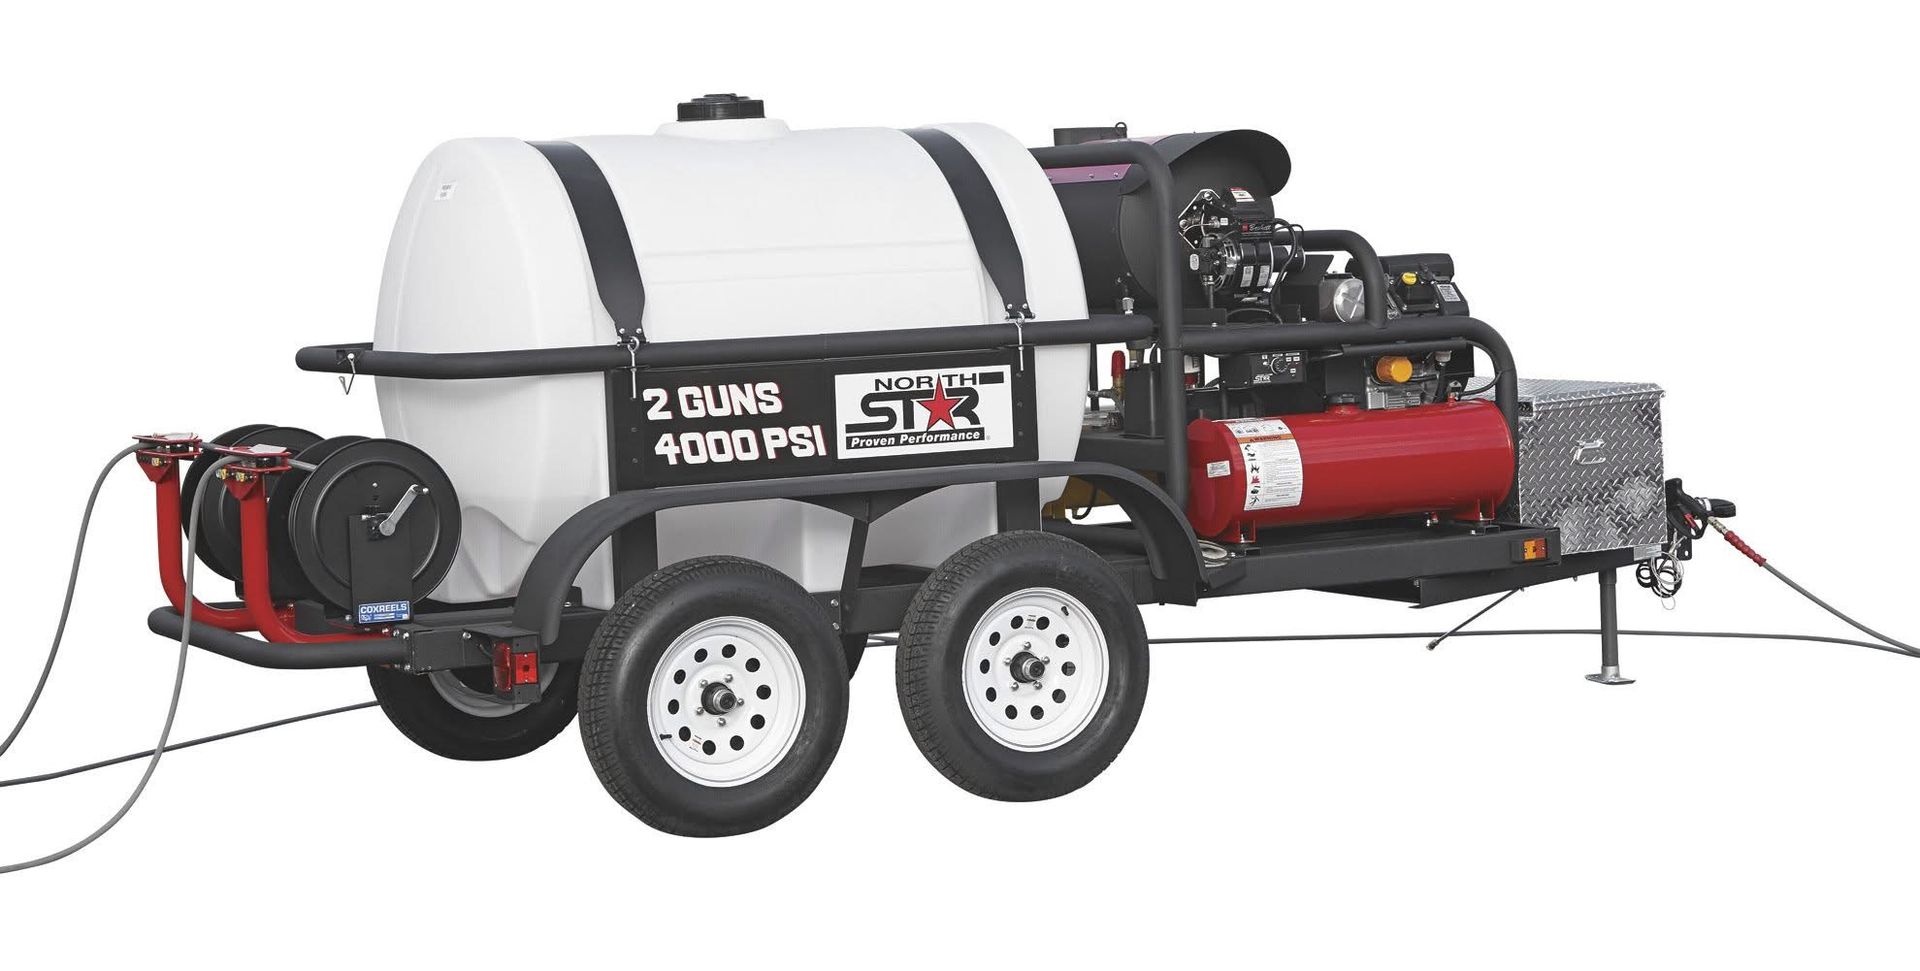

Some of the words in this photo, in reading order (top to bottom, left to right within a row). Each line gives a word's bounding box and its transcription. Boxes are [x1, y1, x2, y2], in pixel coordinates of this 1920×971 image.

[875, 373, 977, 391] NORTH
[642, 388, 673, 421] 2
[677, 382, 784, 419] GUNS
[654, 429, 761, 466] 4000
[762, 425, 828, 460] PSI
[851, 435, 896, 448] Proven
[900, 430, 981, 444] Performance
[360, 603, 407, 614] COXREELS
